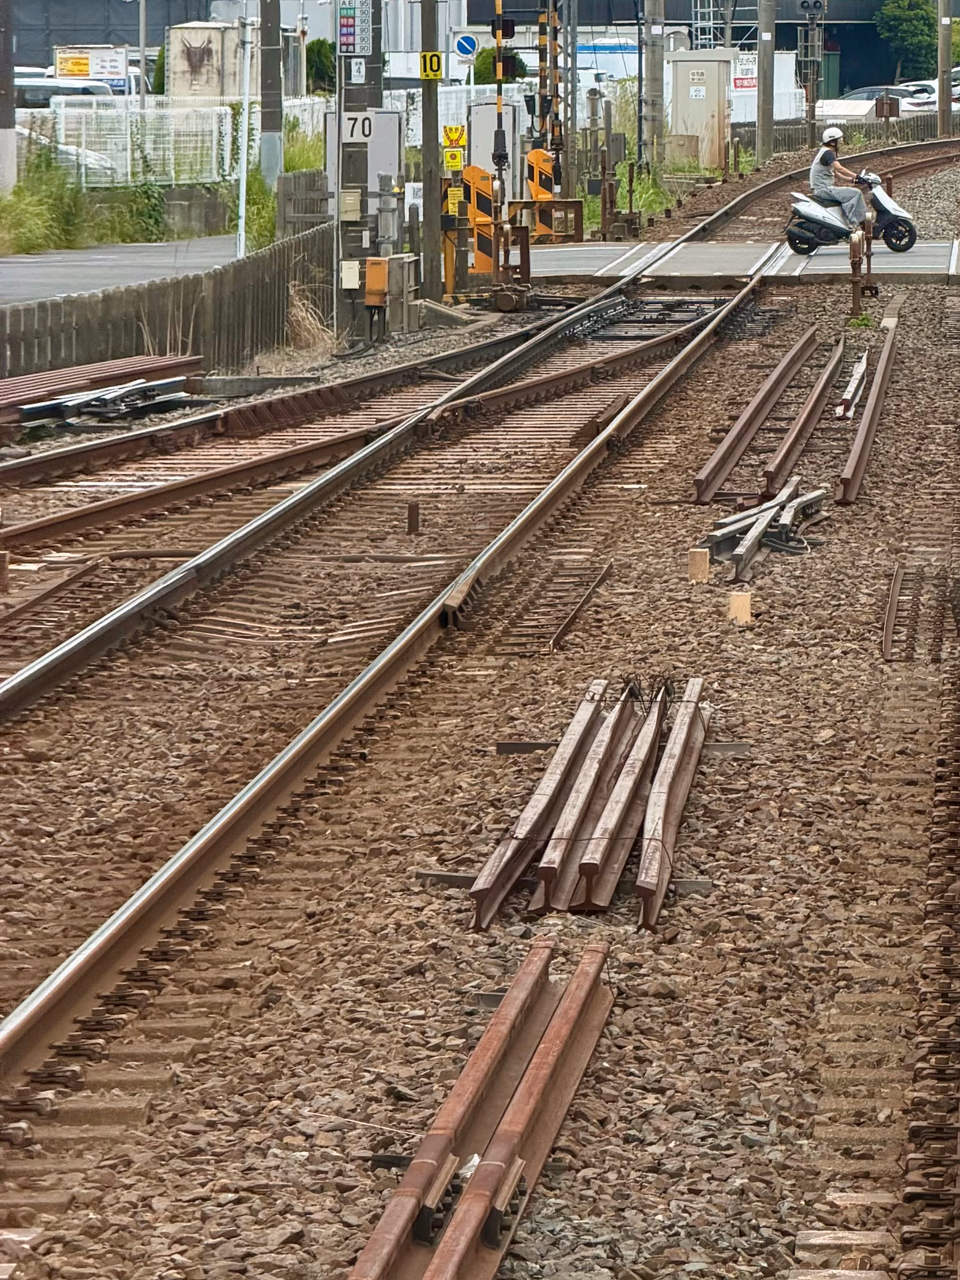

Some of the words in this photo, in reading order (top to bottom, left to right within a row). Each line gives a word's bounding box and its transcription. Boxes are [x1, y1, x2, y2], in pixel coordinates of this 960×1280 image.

[355, 66, 361, 75] 4
[421, 53, 441, 73] 10
[347, 116, 372, 138] 70
